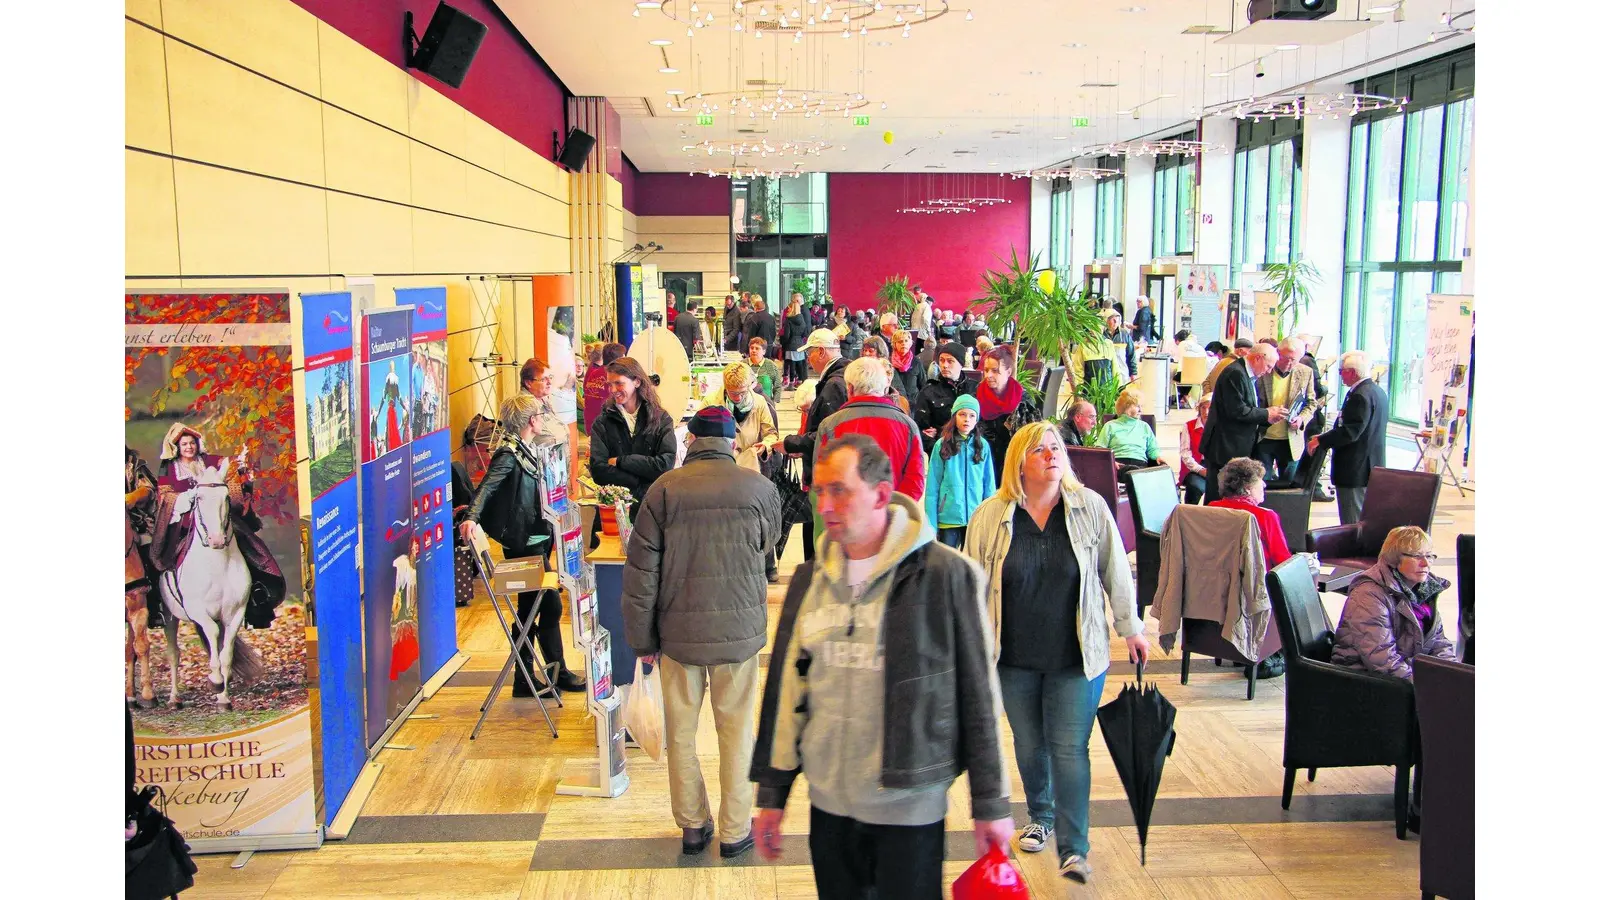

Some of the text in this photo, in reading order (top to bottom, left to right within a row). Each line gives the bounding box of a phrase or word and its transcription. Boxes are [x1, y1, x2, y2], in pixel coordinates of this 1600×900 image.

[160, 318, 213, 344] erleben
[371, 340, 396, 355] Schaumburger
[135, 762, 286, 784] REITSCHULE
